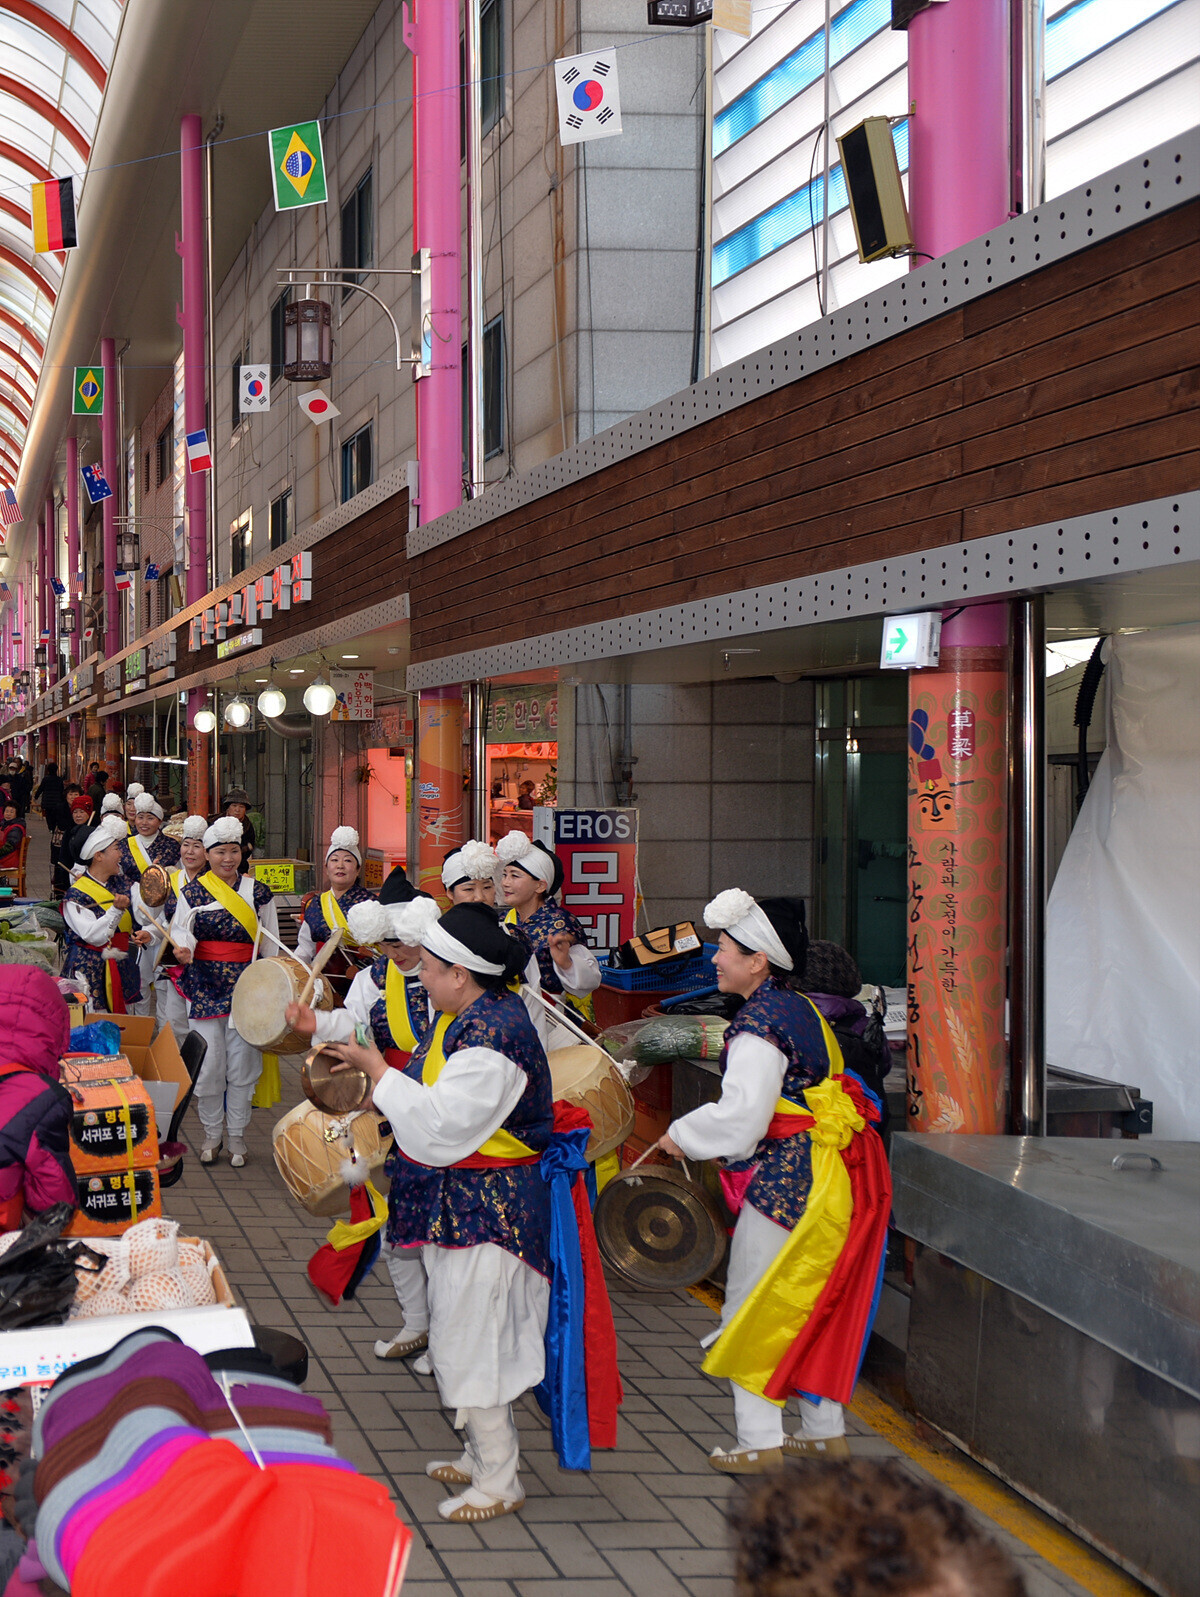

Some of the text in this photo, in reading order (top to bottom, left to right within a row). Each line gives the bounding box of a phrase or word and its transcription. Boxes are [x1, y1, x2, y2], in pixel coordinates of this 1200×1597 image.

[354, 681, 363, 718] 한우고기
[364, 681, 373, 718] 백화점
[514, 699, 541, 730] 한우
[951, 710, 973, 757] 草梁
[559, 814, 631, 839] EROS
[939, 841, 959, 993] 사랑과 온정이 가득한
[81, 1127, 113, 1143] 서귀포
[86, 1194, 118, 1209] 서귀포
[37, 1361, 78, 1376] 농산
